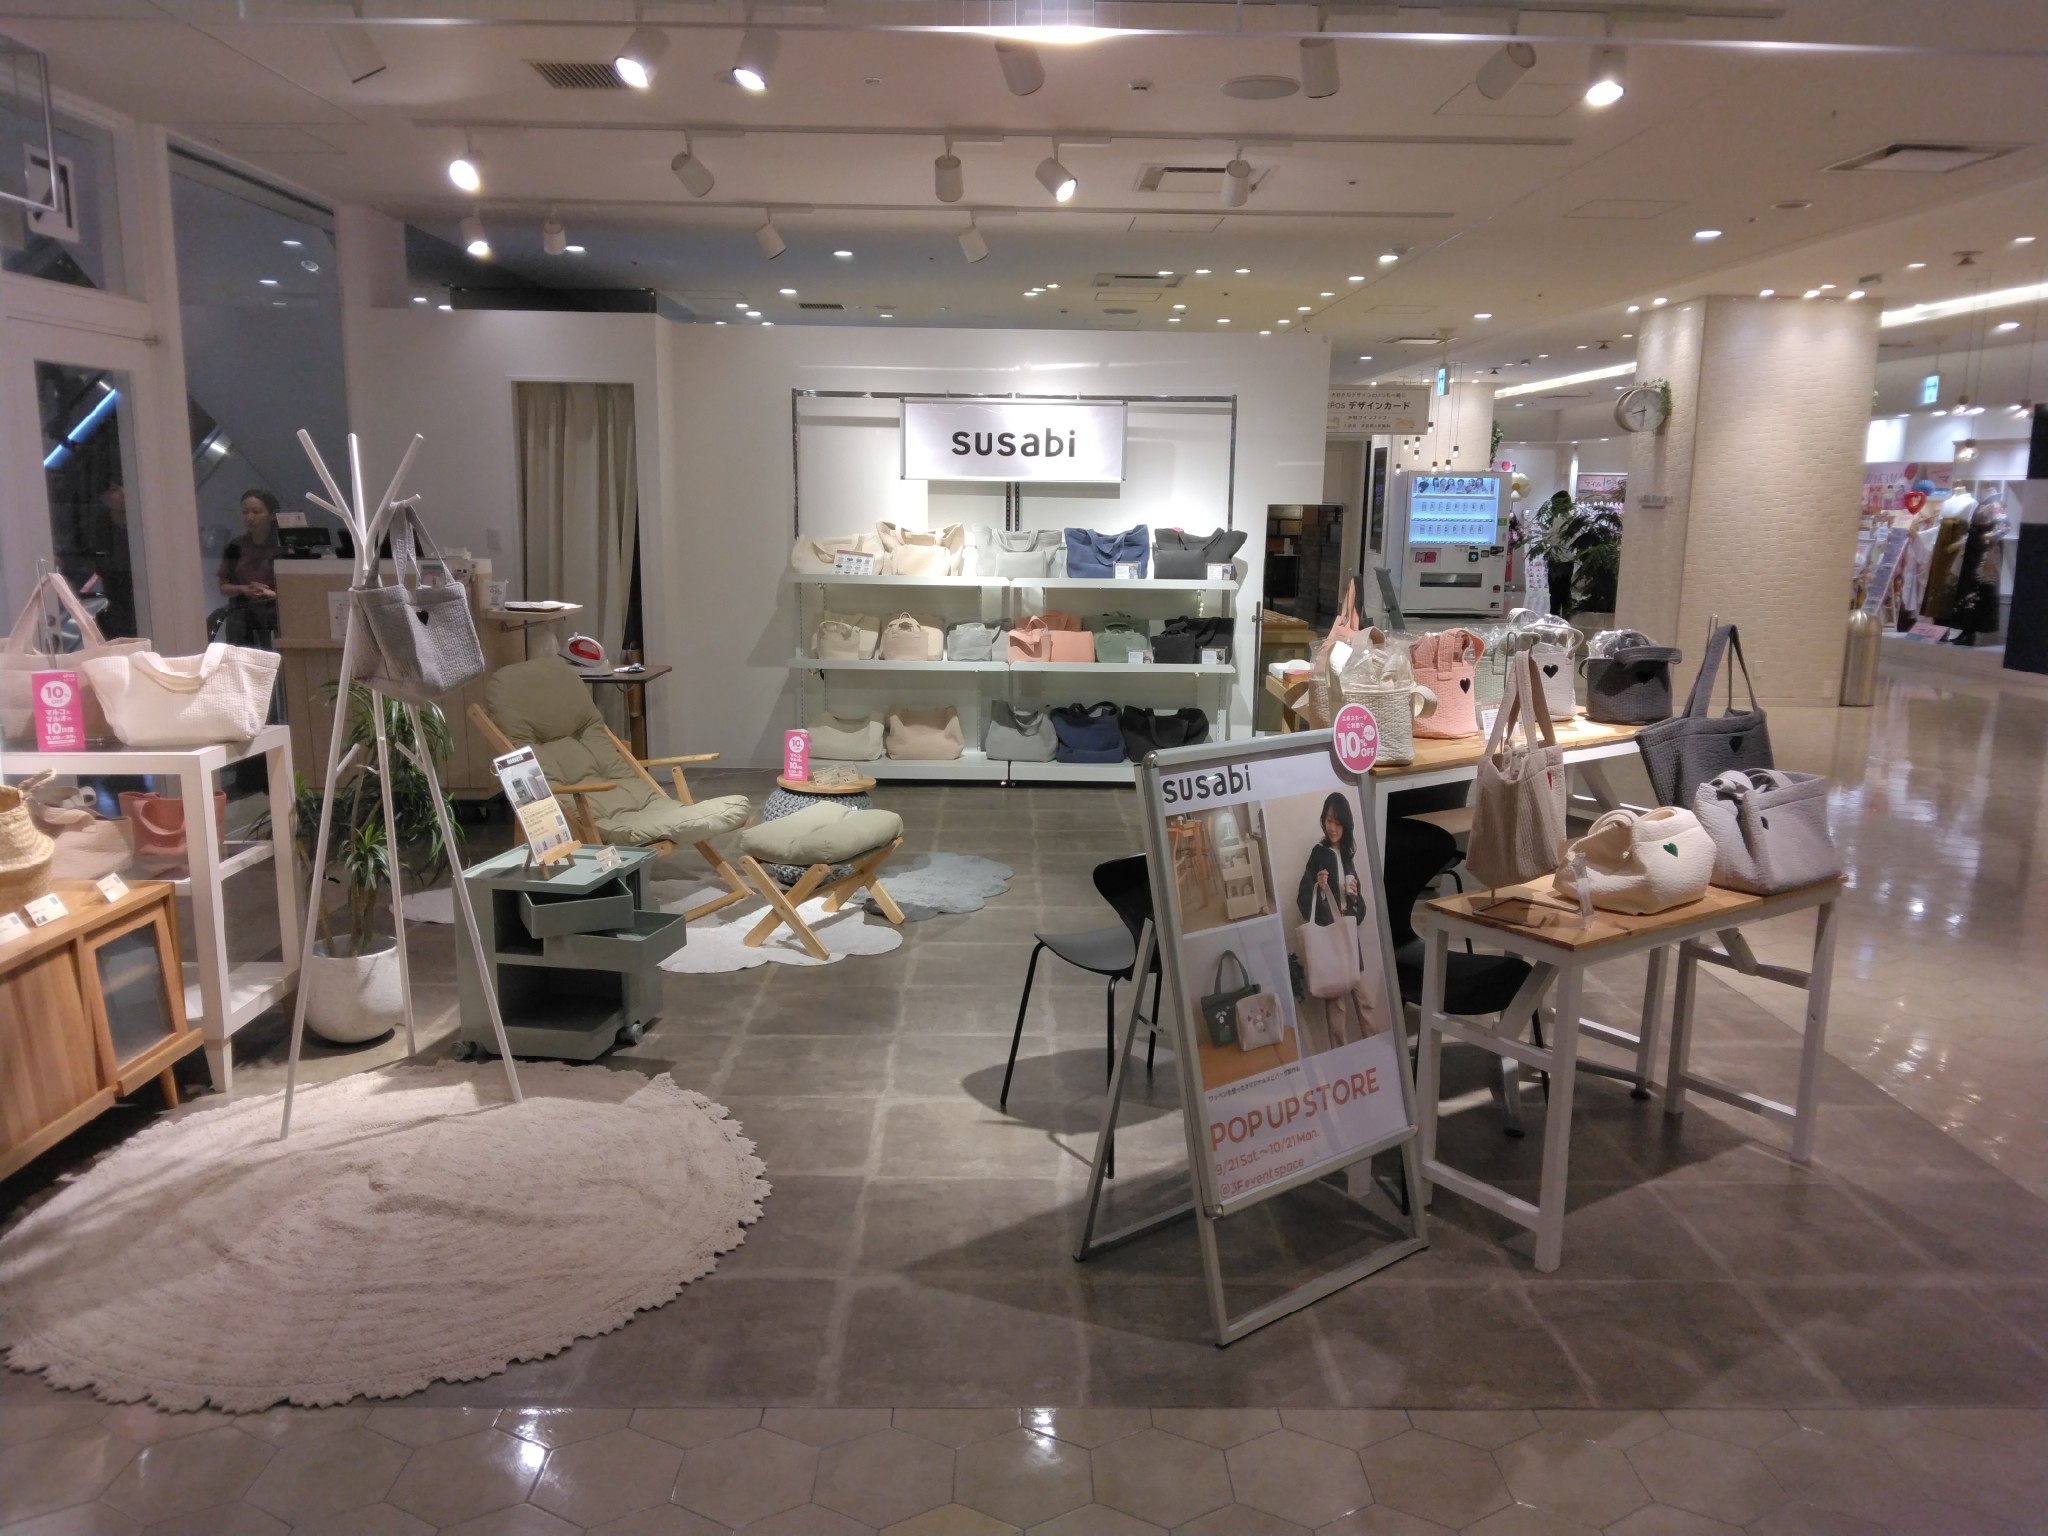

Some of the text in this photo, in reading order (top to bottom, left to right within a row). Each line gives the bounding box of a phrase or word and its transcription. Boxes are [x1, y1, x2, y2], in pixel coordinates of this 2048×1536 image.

[1349, 401, 1411, 410] デザインカード
[952, 428, 1075, 457] susabi
[1361, 747, 1374, 757] OFF
[1162, 764, 1251, 804] susabi
[1210, 1067, 1379, 1151] POP UP STORE
